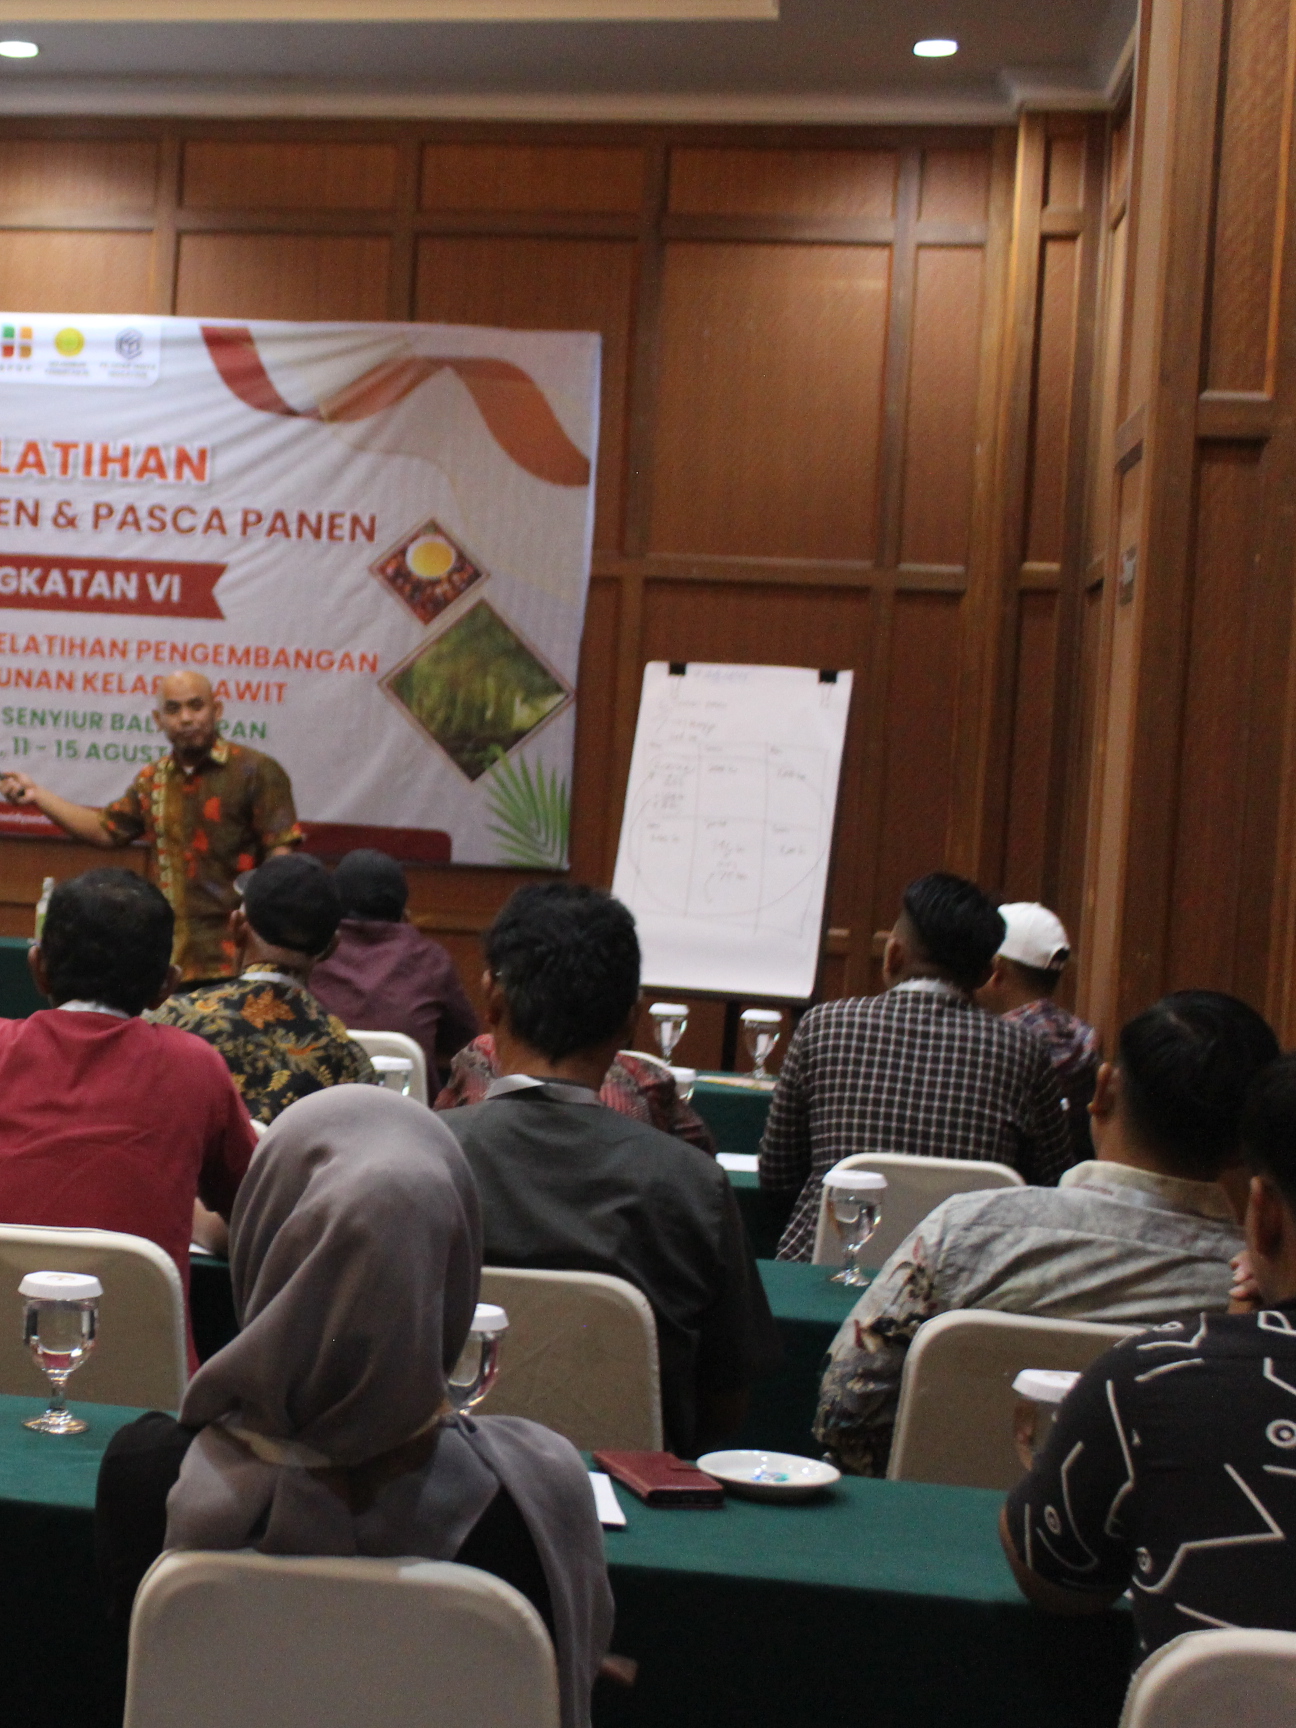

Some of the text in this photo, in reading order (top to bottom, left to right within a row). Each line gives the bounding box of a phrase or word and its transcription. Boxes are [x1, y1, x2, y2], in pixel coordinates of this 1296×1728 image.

[51, 500, 78, 529] &
[92, 503, 227, 536] PASCA
[240, 508, 376, 543] PANEN
[145, 573, 181, 604] VI
[136, 640, 379, 673] PENGEMBANGAN
[82, 671, 162, 696] KELAP
[213, 680, 288, 703] AWIT
[2, 705, 103, 729] SENYIUR
[12, 736, 30, 756] 11
[55, 739, 78, 759] 15
[84, 742, 171, 764] AGUST
